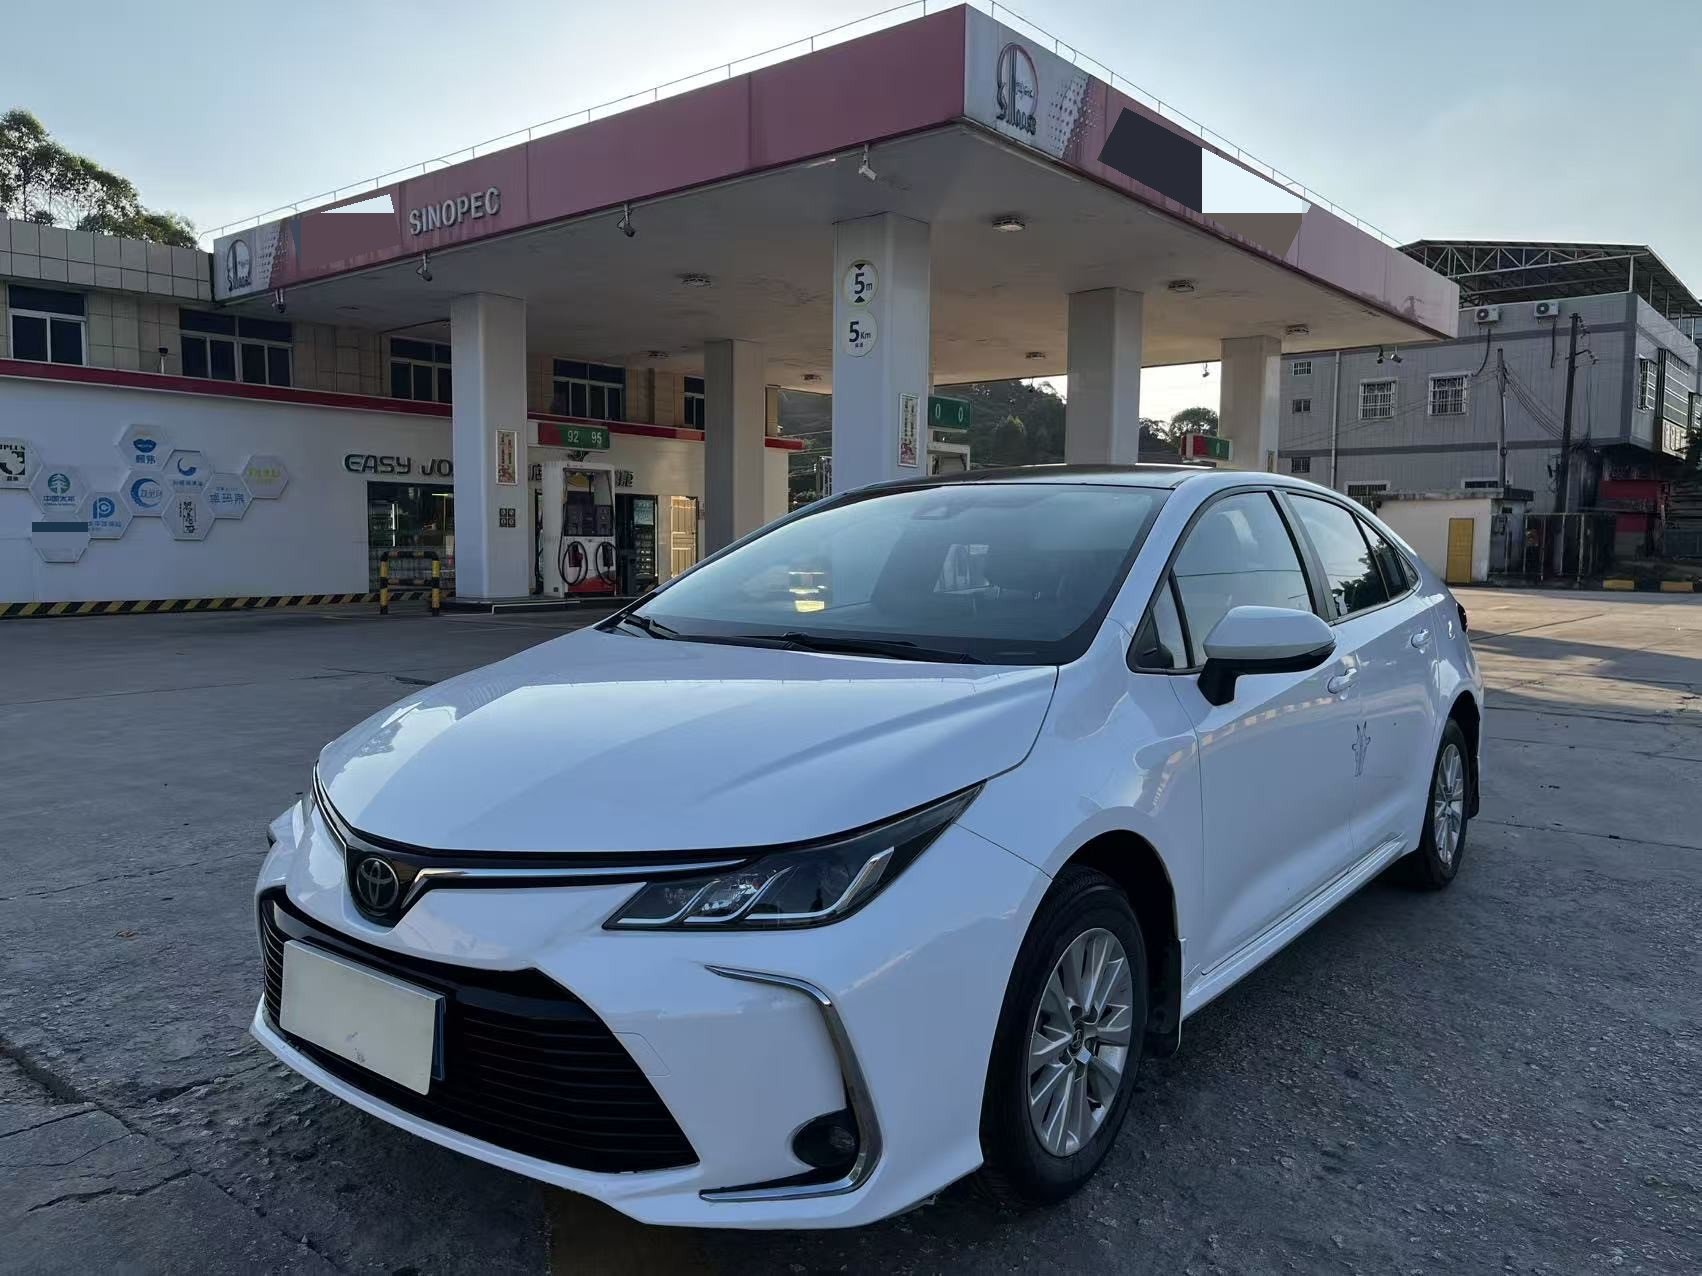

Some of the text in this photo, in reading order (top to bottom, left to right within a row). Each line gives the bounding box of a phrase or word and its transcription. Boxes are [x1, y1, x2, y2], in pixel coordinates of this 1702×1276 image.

[409, 187, 499, 235] SINOPEC
[567, 430, 602, 444] 92 95
[344, 454, 412, 474] EASY
